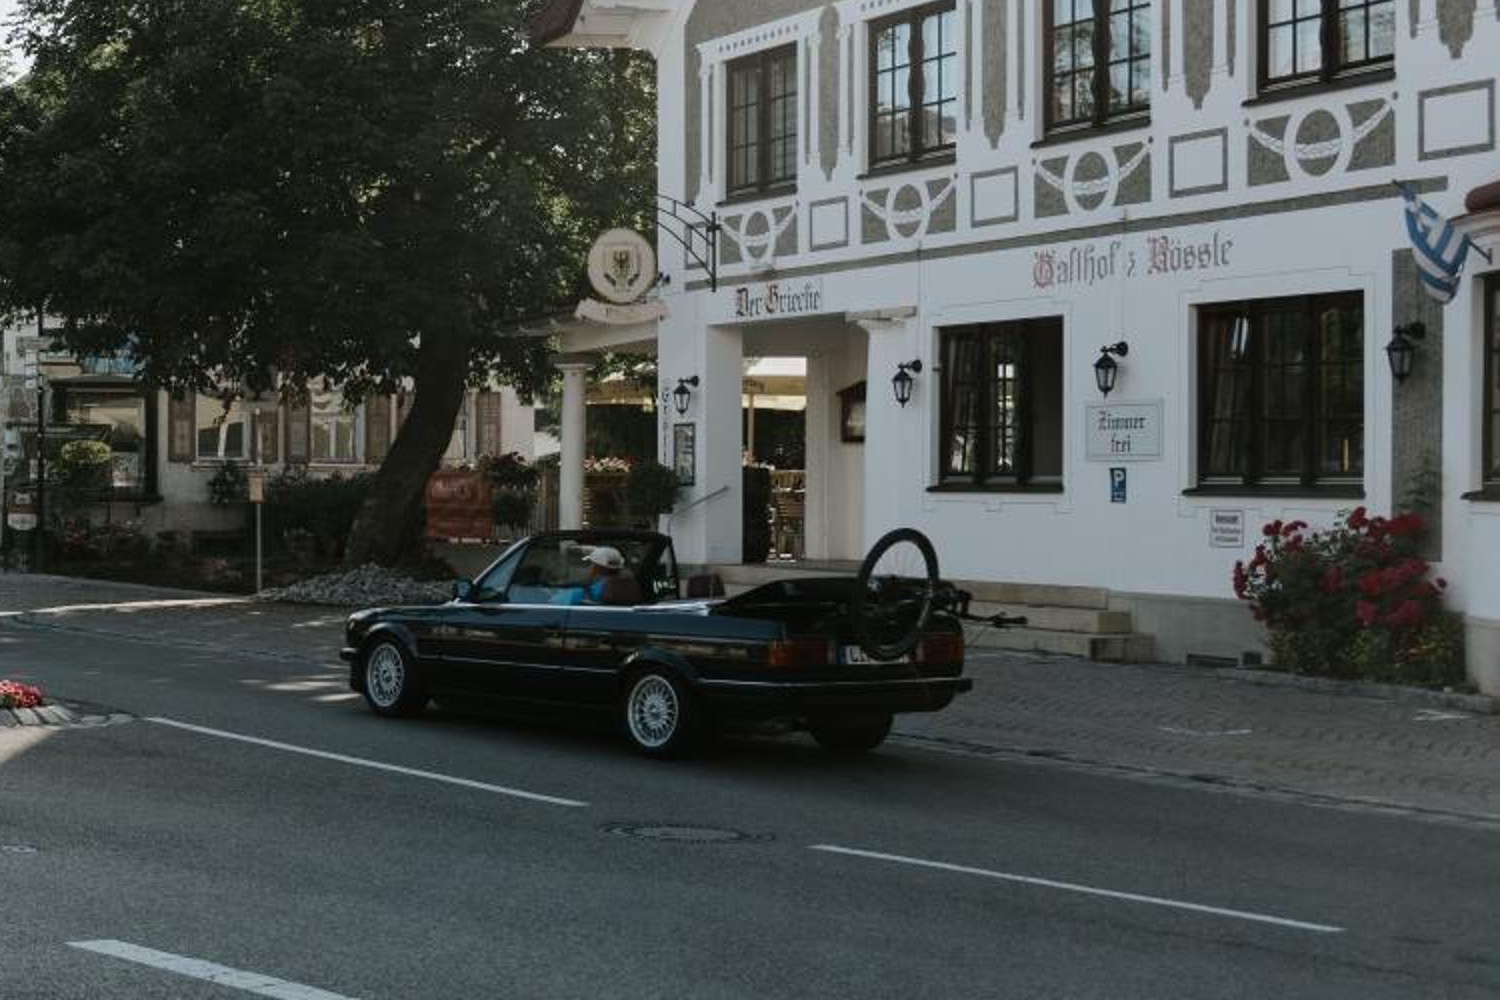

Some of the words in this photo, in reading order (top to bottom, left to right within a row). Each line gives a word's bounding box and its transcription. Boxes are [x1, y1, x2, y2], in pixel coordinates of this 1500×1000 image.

[1147, 231, 1234, 275] Rössle
[736, 287, 763, 317] Der
[1097, 410, 1147, 431] Zimmer
[1110, 432, 1131, 454] frei
[1113, 470, 1125, 488] P
